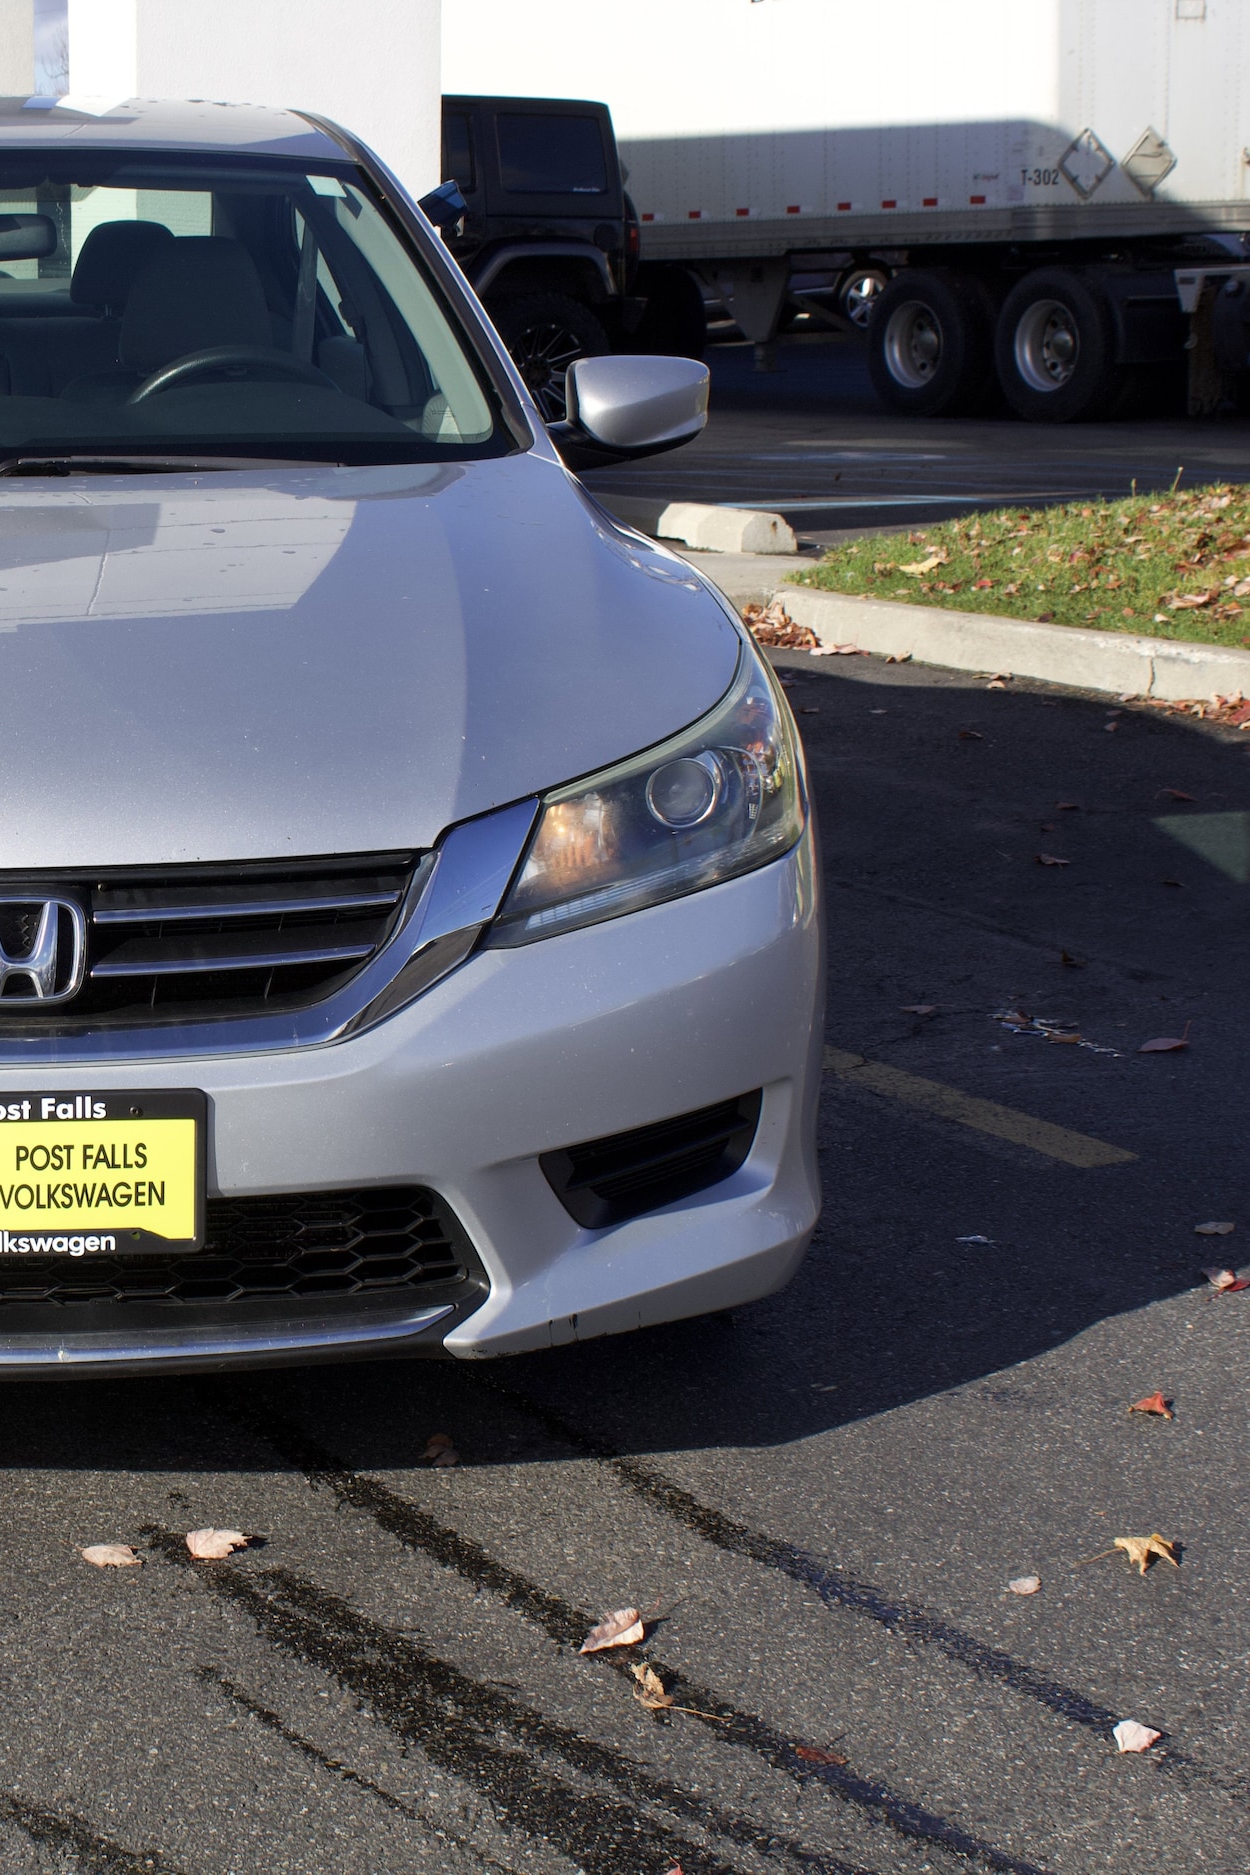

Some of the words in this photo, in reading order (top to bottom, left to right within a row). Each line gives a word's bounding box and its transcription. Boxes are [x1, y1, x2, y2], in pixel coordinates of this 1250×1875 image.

[1021, 168, 1059, 186] T-302
[40, 1096, 107, 1120] Falls
[15, 1144, 75, 1171] POST
[81, 1142, 148, 1169] FALLS
